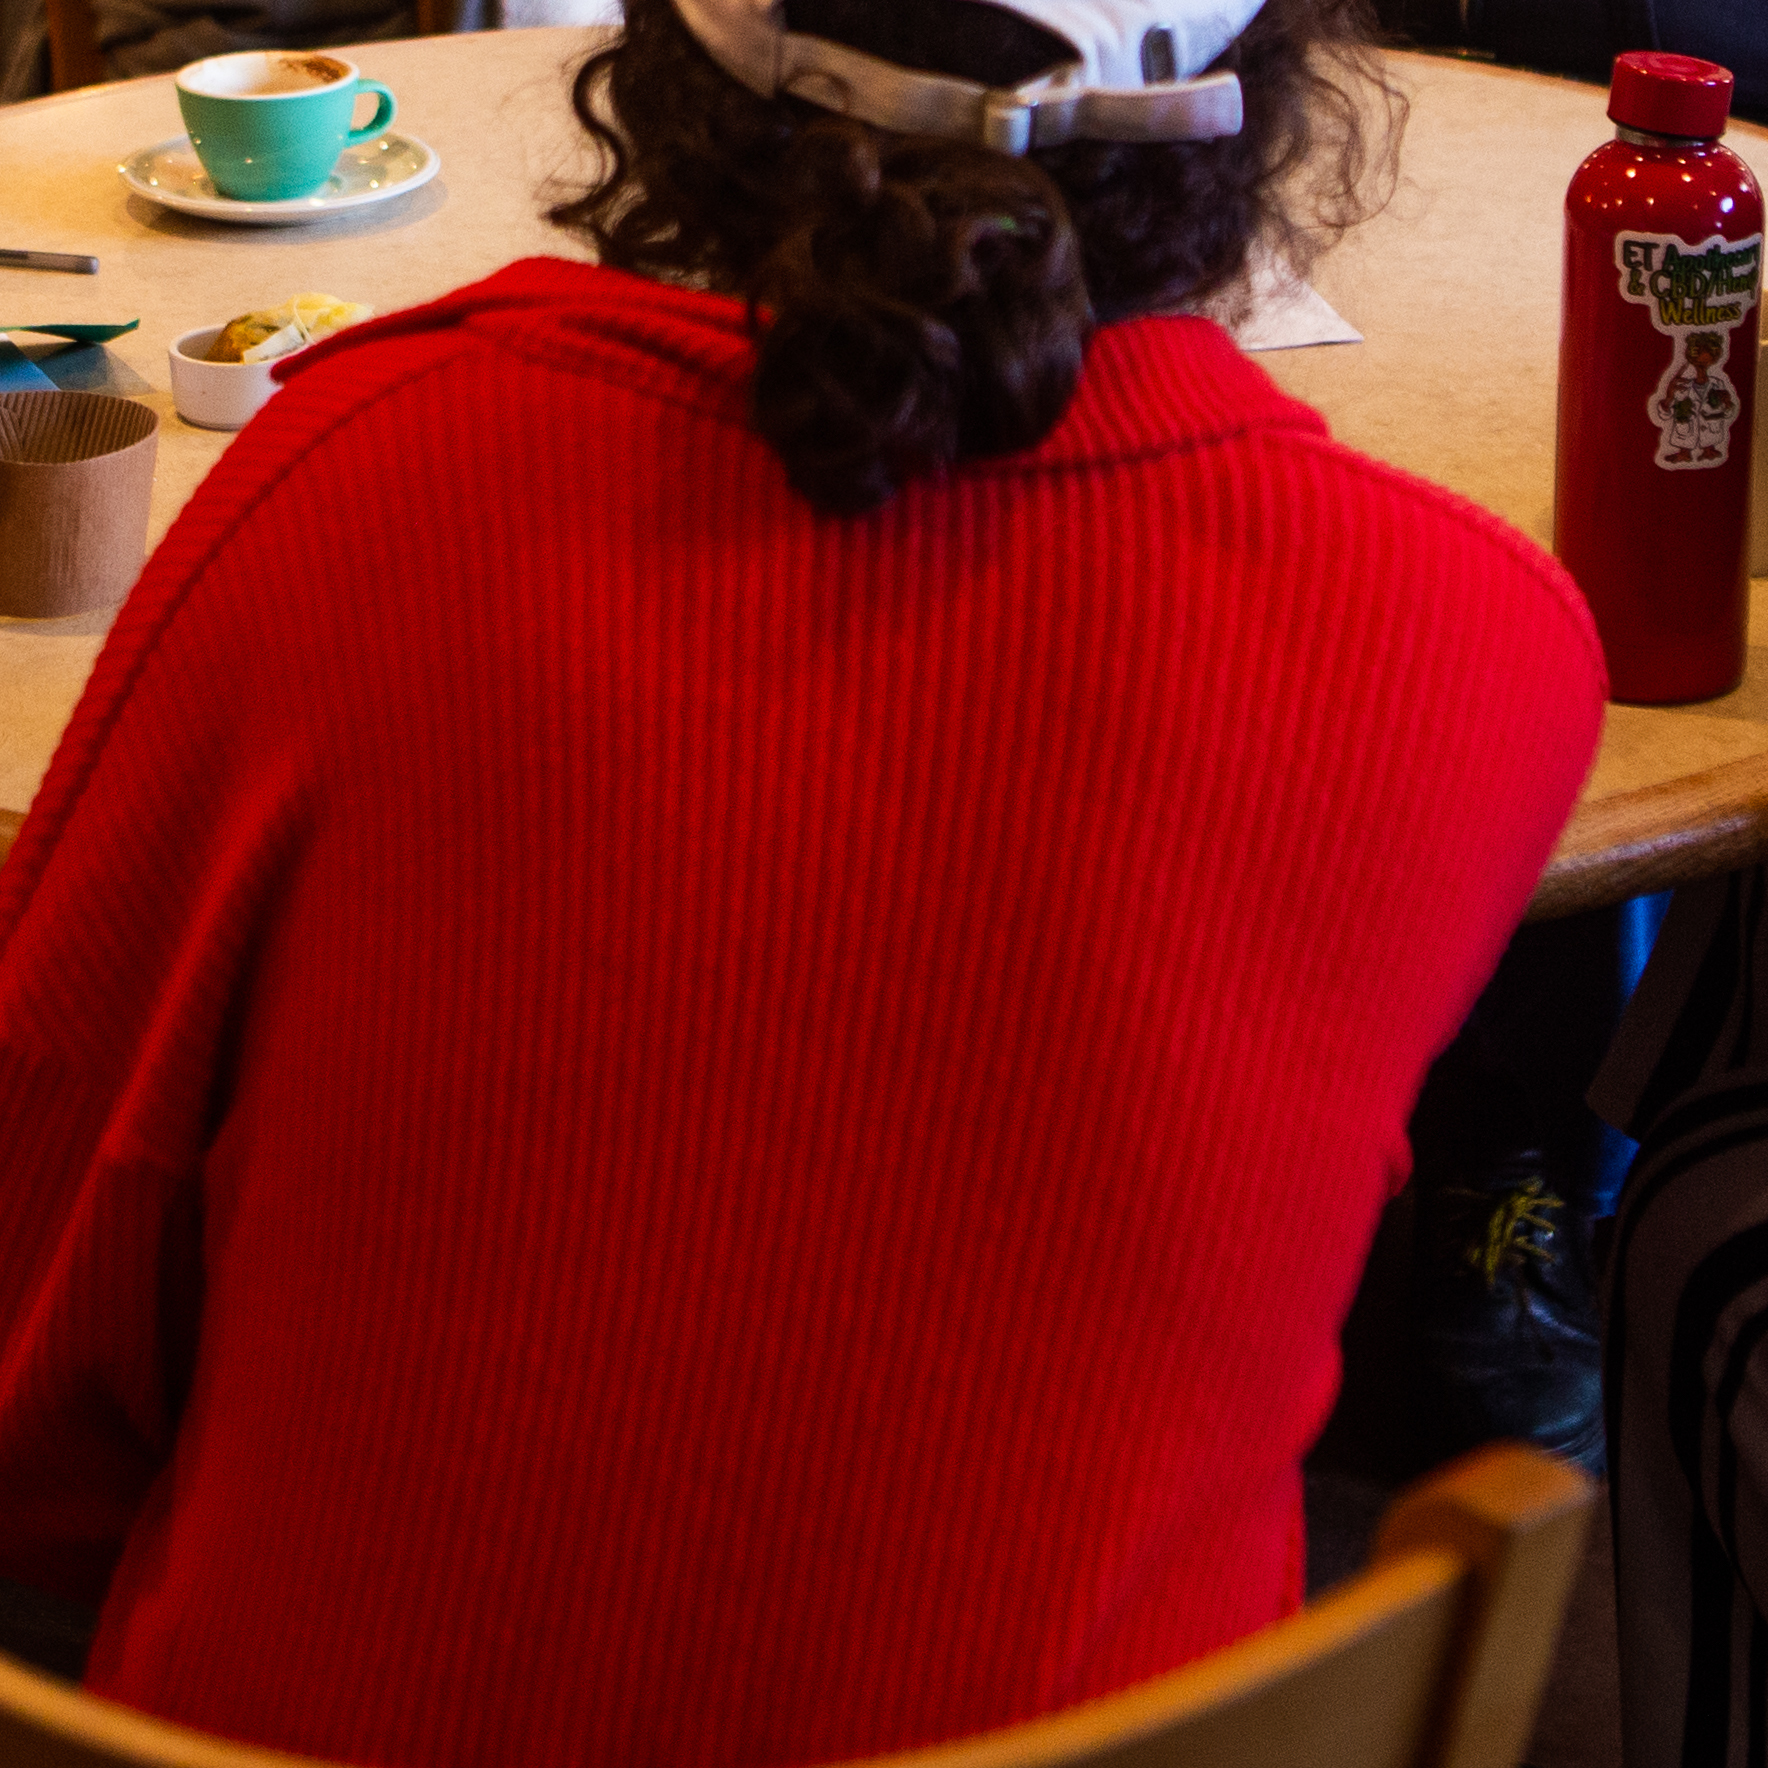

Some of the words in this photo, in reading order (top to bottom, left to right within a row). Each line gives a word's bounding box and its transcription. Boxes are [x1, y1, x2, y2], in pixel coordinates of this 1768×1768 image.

[1623, 240, 1660, 271] ET
[1627, 269, 1646, 296] &
[1659, 298, 1742, 326] Wellness
